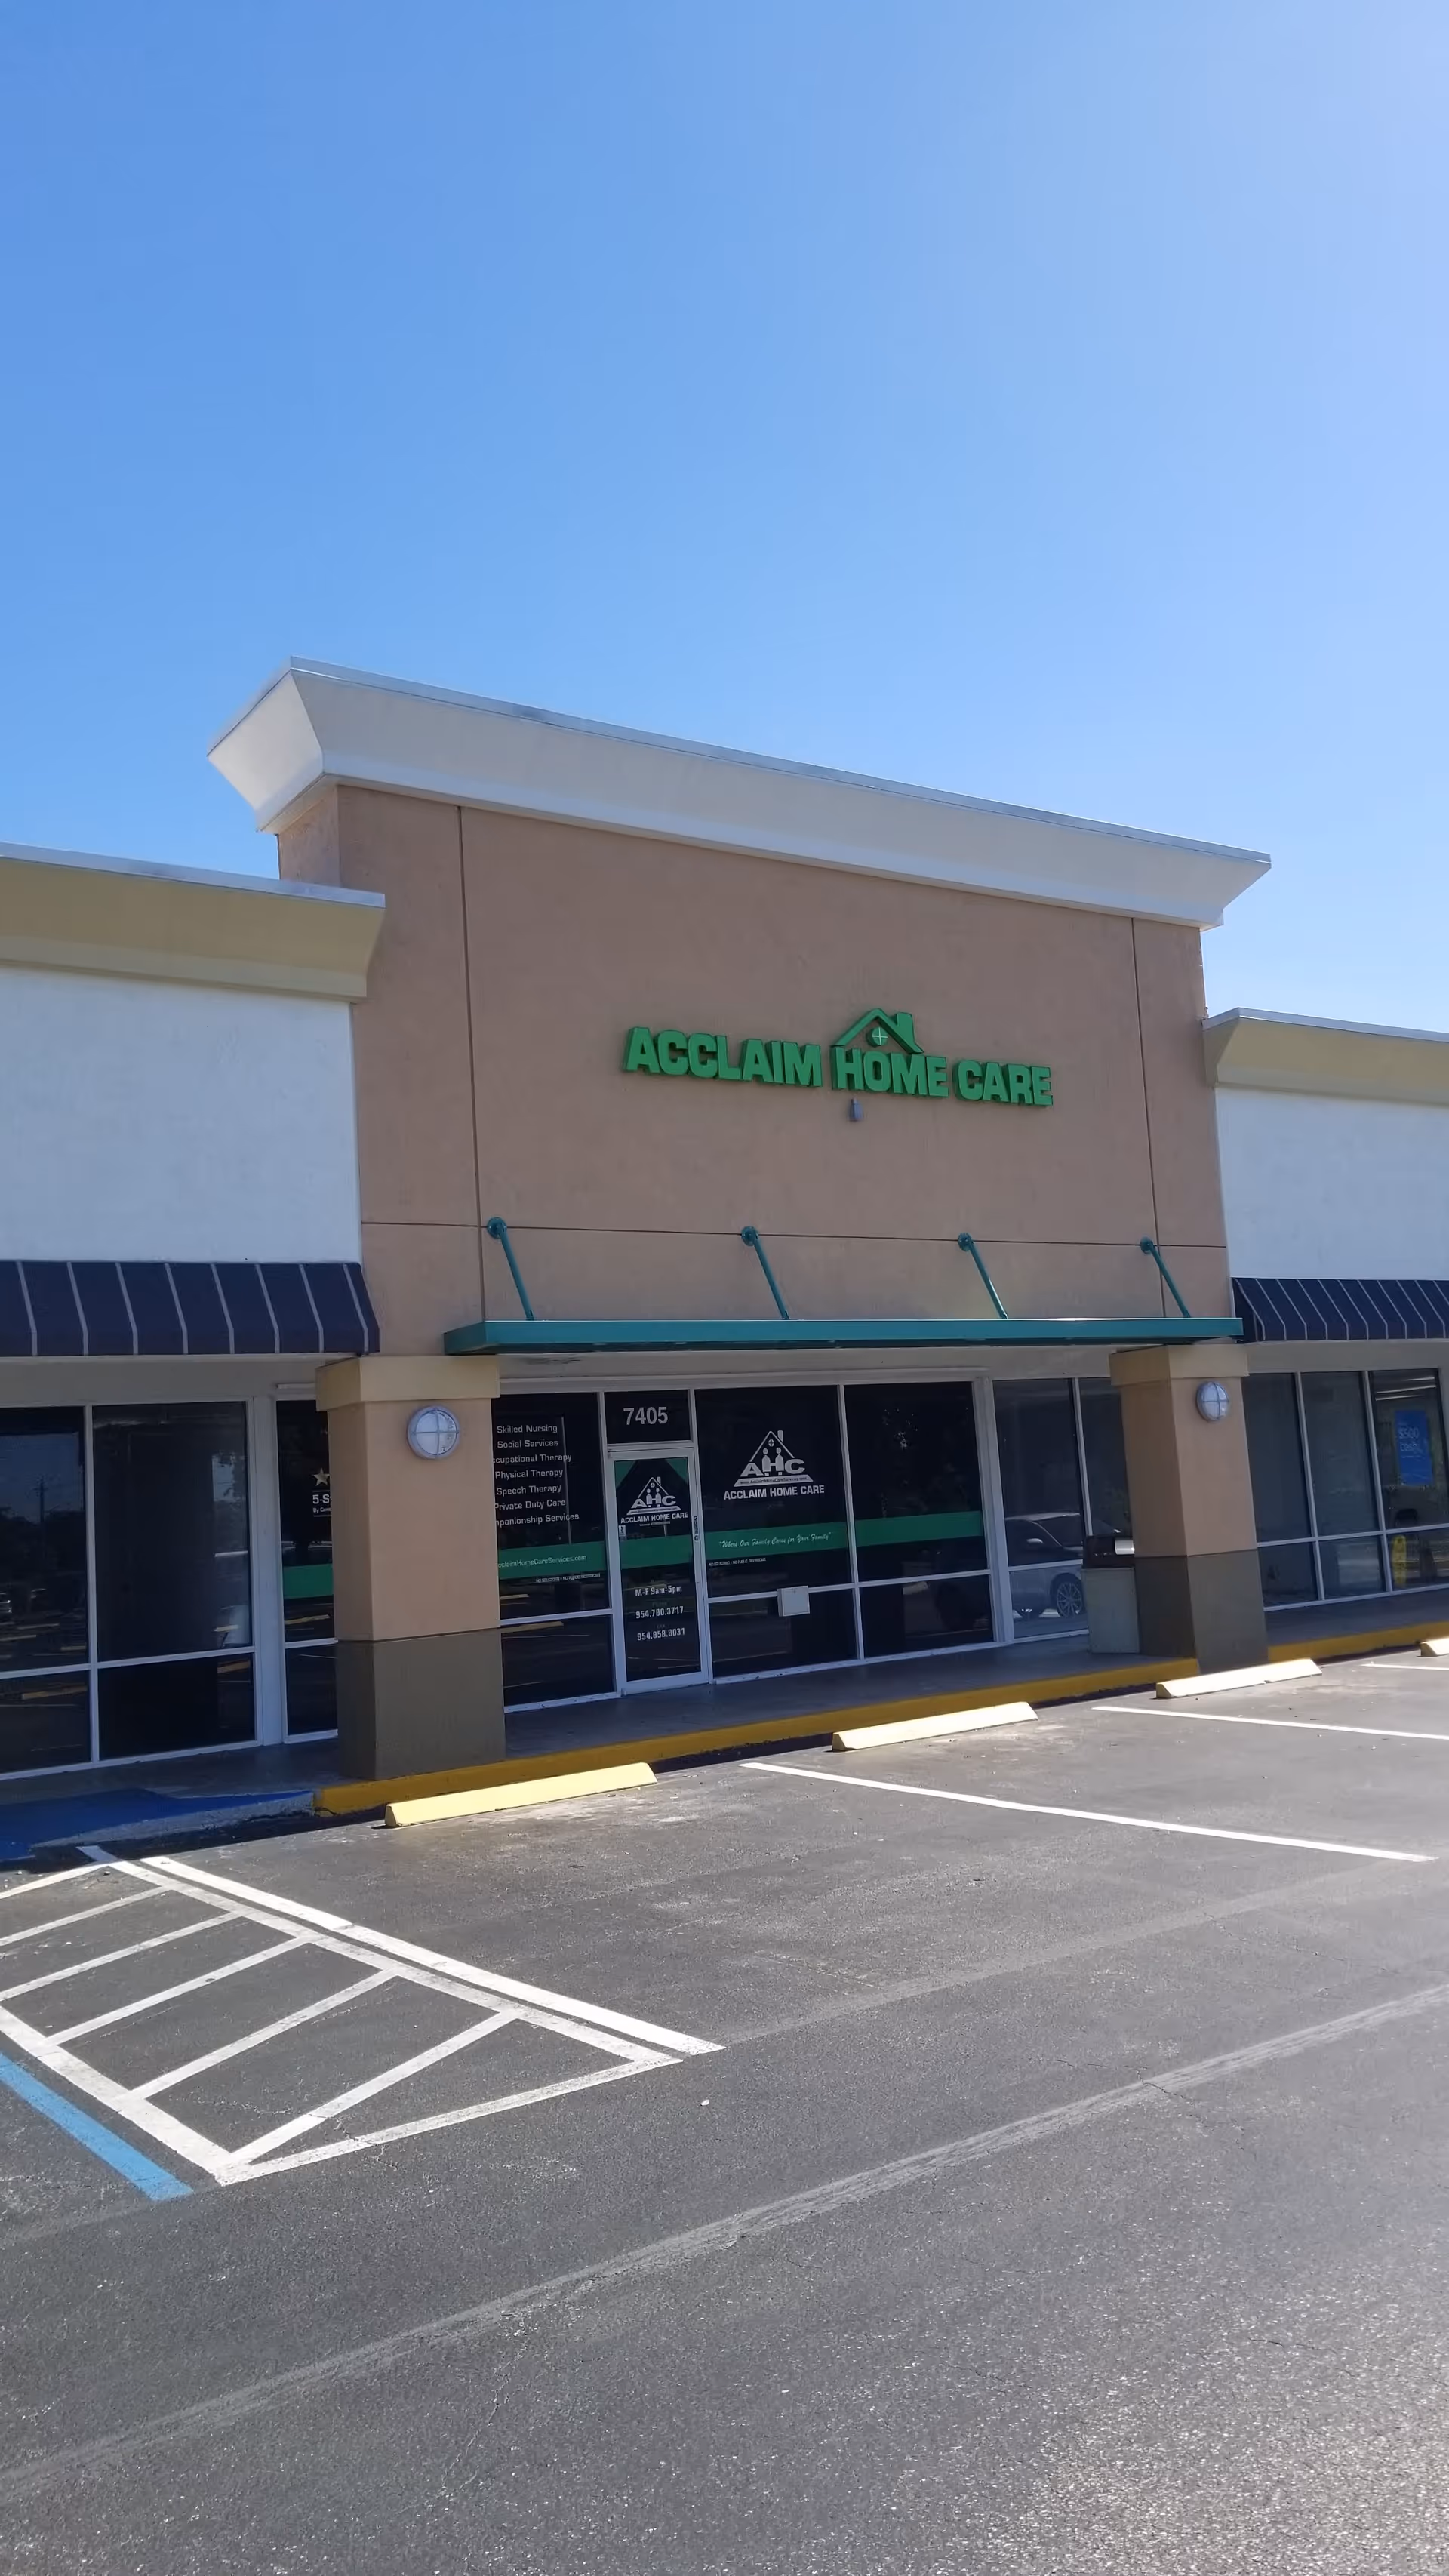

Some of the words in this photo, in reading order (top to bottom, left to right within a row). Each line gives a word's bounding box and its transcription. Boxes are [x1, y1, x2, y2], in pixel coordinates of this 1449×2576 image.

[623, 1026, 823, 1088] ACCLAIM
[831, 1045, 949, 1099] HOME
[954, 1059, 1054, 1106] CARE
[623, 1406, 669, 1426] 7405
[497, 1425, 523, 1433] Skilled
[526, 1424, 558, 1433] Nursing
[497, 1440, 521, 1448] Social
[524, 1439, 558, 1448] Services
[492, 1454, 537, 1466] ccupational
[540, 1454, 572, 1463] Therapy
[740, 1454, 806, 1477] AHC
[495, 1470, 529, 1481] Physical
[531, 1469, 563, 1479] Therapy
[496, 1486, 526, 1497] Speech
[528, 1485, 561, 1494] Therapy
[723, 1488, 767, 1500] ACCLAIM
[770, 1486, 798, 1497] HOME
[800, 1485, 825, 1495] CARE
[312, 1494, 331, 1505] 5-S
[631, 1492, 677, 1509] AHC
[494, 1502, 523, 1511] Private
[525, 1501, 545, 1510] Duty
[545, 1513, 580, 1523] Services
[620, 1516, 650, 1524] ACCLAIM
[635, 1587, 649, 1597] M-F
[651, 1585, 682, 1595] 9am-5pm
[635, 1605, 684, 1619] 954.780.3717
[637, 1627, 686, 1641] 954.858.8031
